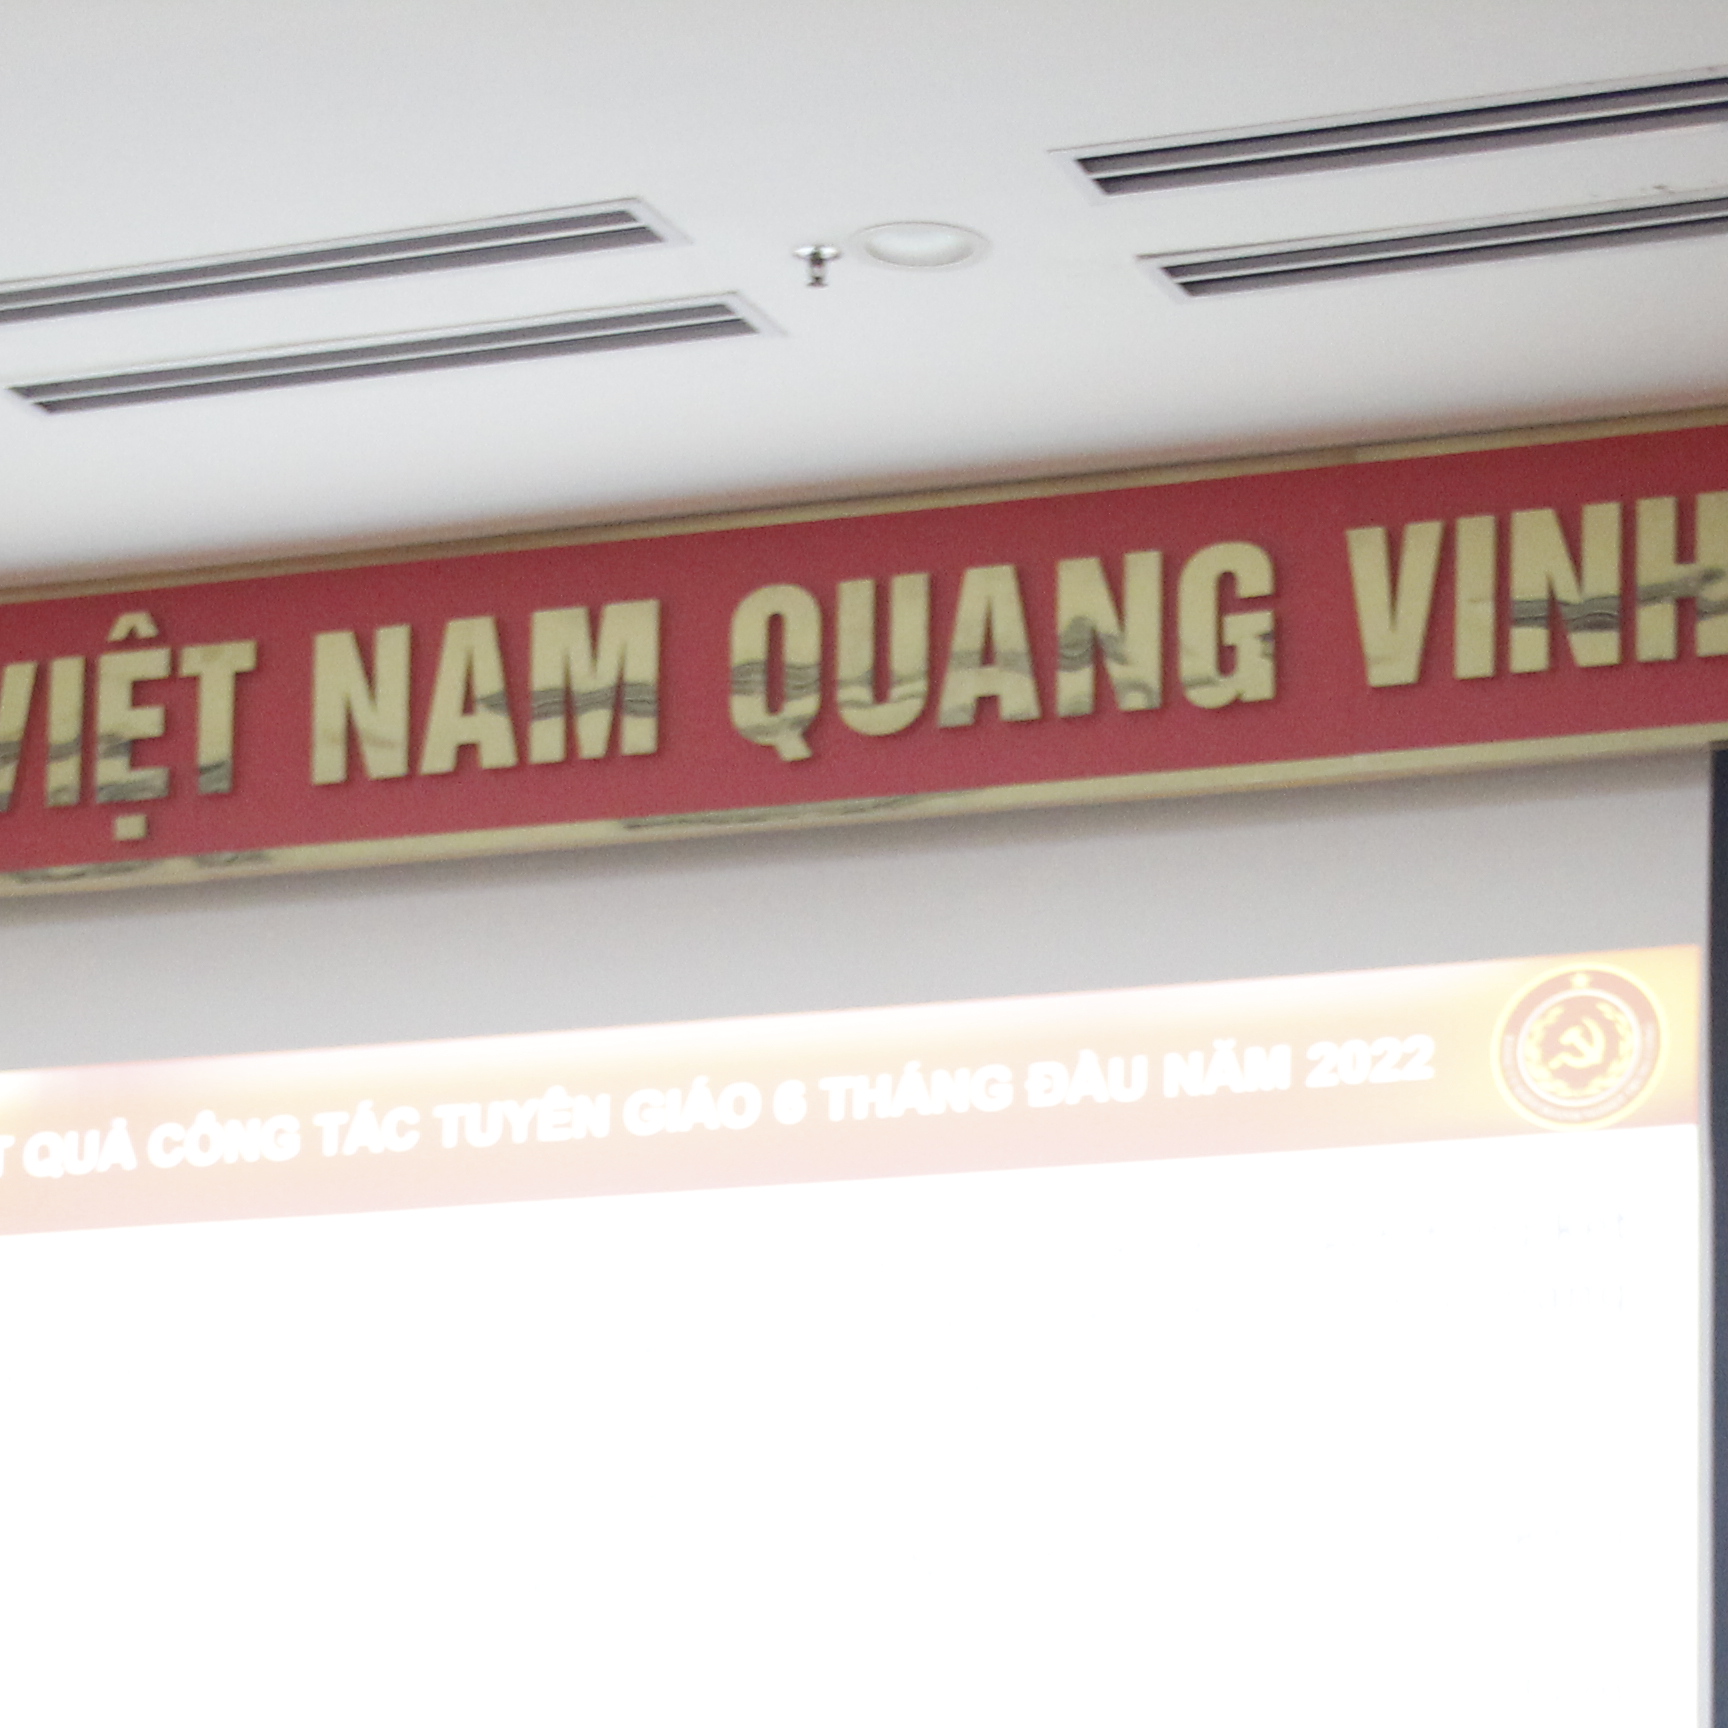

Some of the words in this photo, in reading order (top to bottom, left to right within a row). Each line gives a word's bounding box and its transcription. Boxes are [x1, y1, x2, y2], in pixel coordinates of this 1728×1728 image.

[309, 598, 662, 787] NAM
[727, 539, 1278, 763] QUANG
[146, 1109, 302, 1169] CÔNG
[311, 1099, 421, 1157] TÁC
[431, 1085, 612, 1149] TUYÊN
[623, 1075, 763, 1137] GIÁO
[772, 1079, 809, 1126] 6
[818, 1060, 1015, 1122] THÁNG
[1162, 1037, 1292, 1099] NĂM
[1304, 1033, 1436, 1089] 2022
